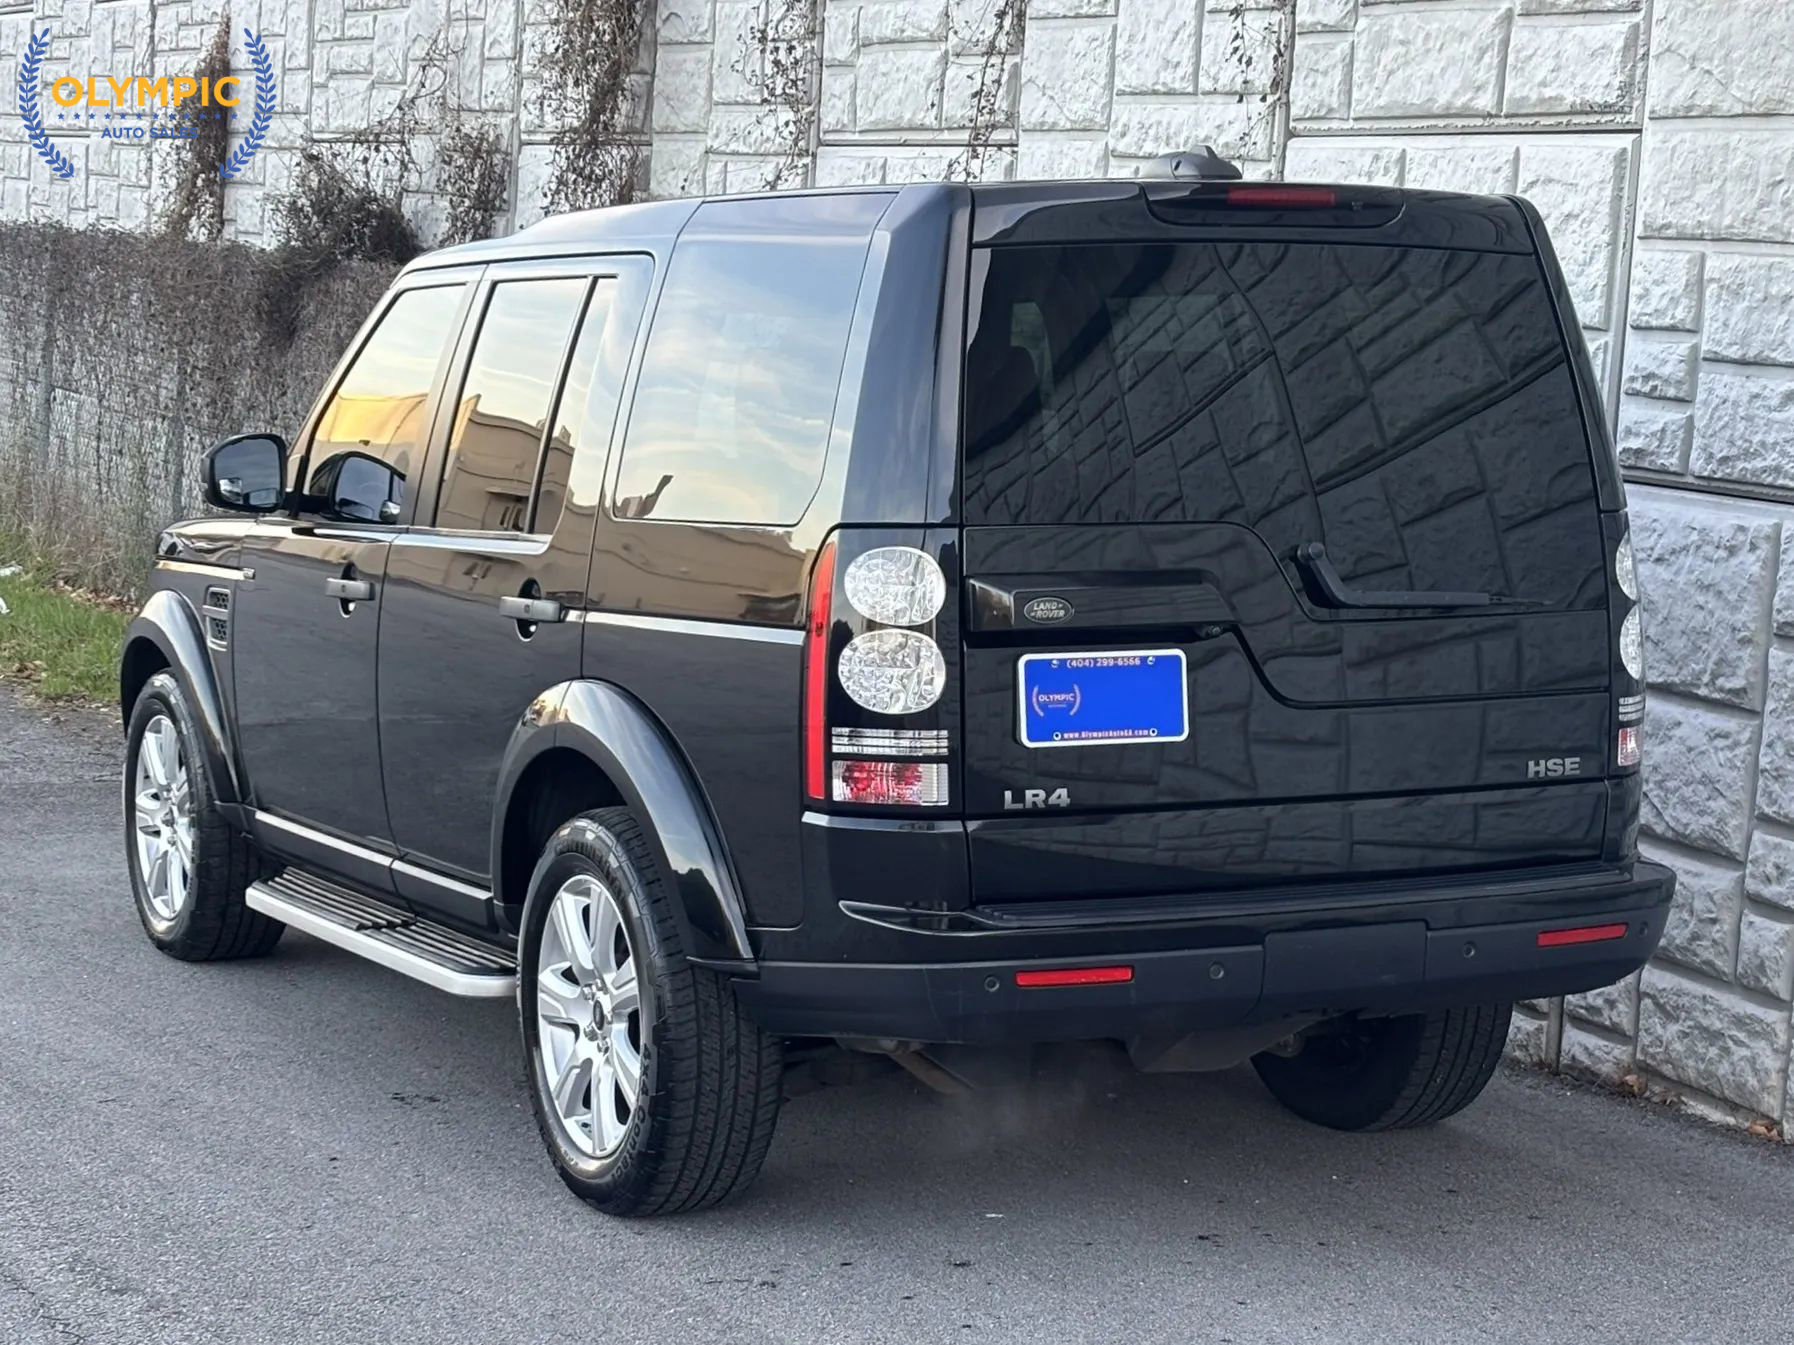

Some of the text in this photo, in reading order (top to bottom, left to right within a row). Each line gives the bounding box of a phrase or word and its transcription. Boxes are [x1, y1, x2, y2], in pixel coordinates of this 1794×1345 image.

[1033, 601, 1058, 610] LAND
[1035, 609, 1065, 618] ROVER
[1066, 658, 1094, 669] (404)
[1038, 693, 1075, 702] OLYMPIC
[1527, 757, 1581, 779] HSE
[1004, 787, 1071, 810] LR4
